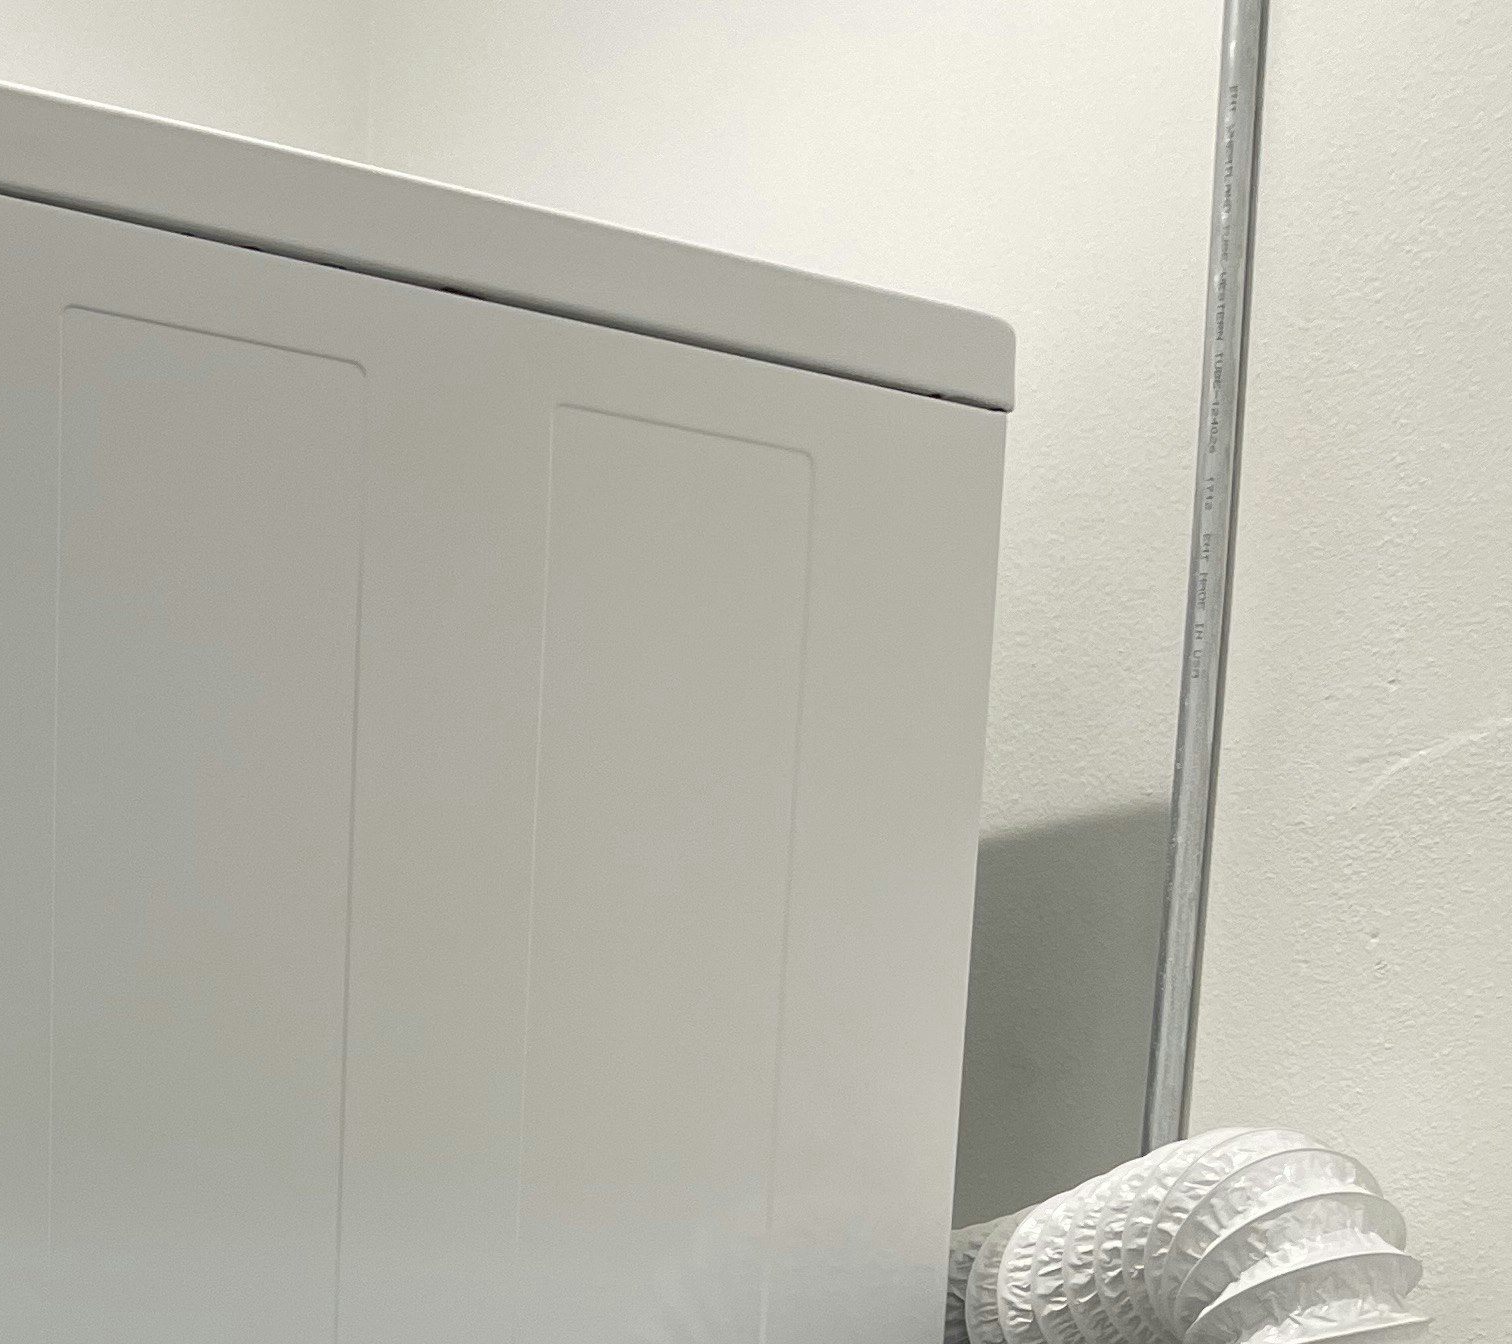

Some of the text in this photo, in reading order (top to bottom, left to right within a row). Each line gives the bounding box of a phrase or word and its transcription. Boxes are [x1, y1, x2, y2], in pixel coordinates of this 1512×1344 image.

[1214, 271, 1228, 341] WESTERN
[1196, 572, 1209, 611] MADE
[1194, 623, 1205, 640] IN
